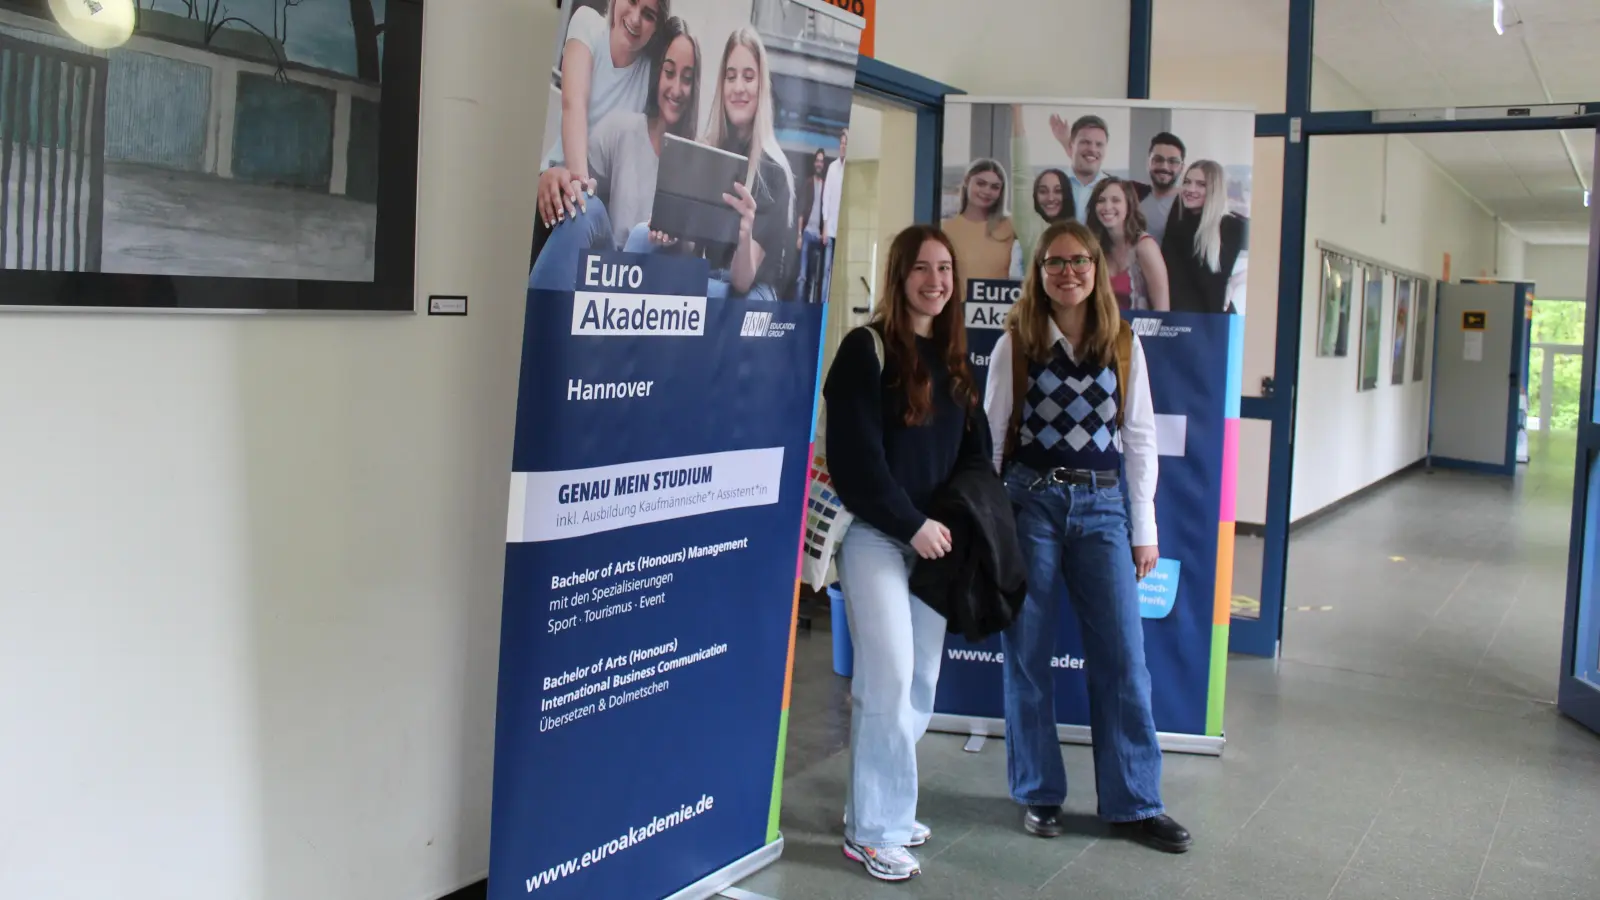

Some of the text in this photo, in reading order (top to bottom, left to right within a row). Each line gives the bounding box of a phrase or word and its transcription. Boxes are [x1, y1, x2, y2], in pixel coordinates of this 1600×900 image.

[584, 254, 643, 288] Euro
[972, 282, 1023, 302] Euro
[580, 298, 700, 331] Akademie
[770, 322, 796, 330] EDUCATION
[567, 378, 653, 401] Hannover
[558, 465, 713, 505] GENAU MEIN STUDIUM
[556, 513, 579, 528] inkl.
[582, 499, 637, 524] Ausbildung
[551, 537, 748, 590] Bachelor of Arts (Honours) Management
[549, 570, 674, 612] mit den Spezialisierungen
[547, 591, 666, 634] Sport Tourismus Event
[541, 642, 728, 712] International Business Communication
[543, 637, 678, 691] Bachelor of Arts (Honours)
[539, 679, 670, 733] Übersetzen & Dolmetschen
[525, 794, 714, 893] www.euroakademie.de
